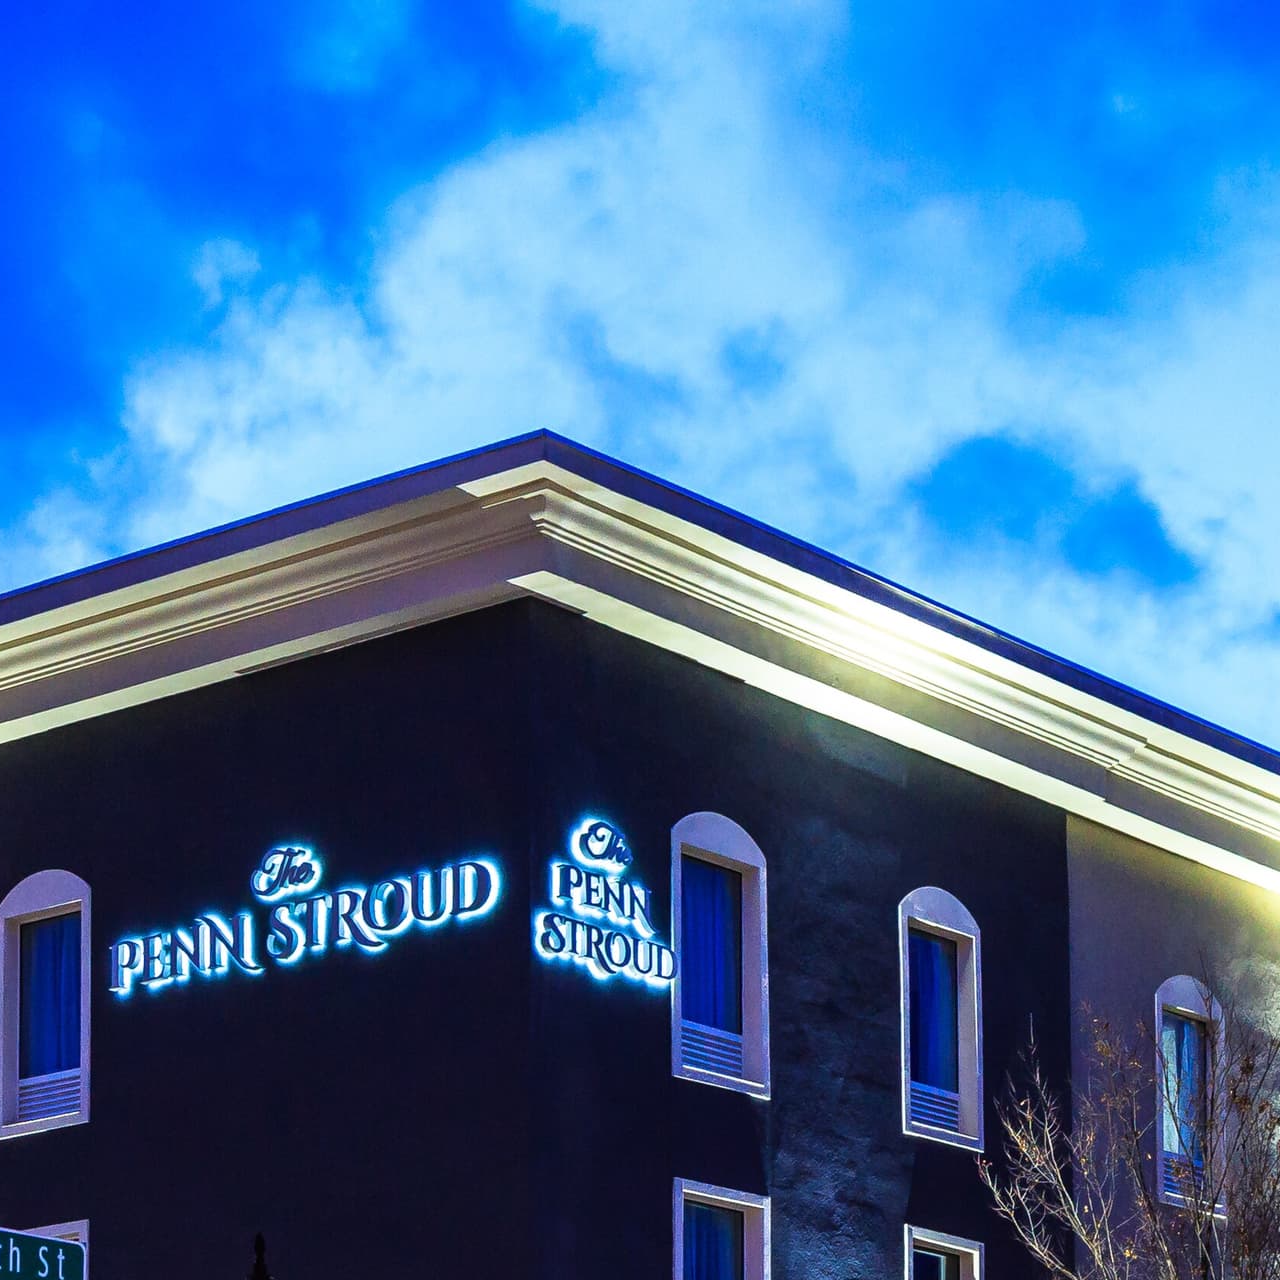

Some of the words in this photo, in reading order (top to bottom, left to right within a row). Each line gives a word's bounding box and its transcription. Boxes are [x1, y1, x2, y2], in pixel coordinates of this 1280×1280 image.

[251, 847, 316, 898] The
[556, 863, 658, 935] PENN
[108, 914, 266, 993] PENN
[267, 861, 495, 961] STROUD
[540, 912, 678, 980] STROUD
[38, 1246, 66, 1280] St
